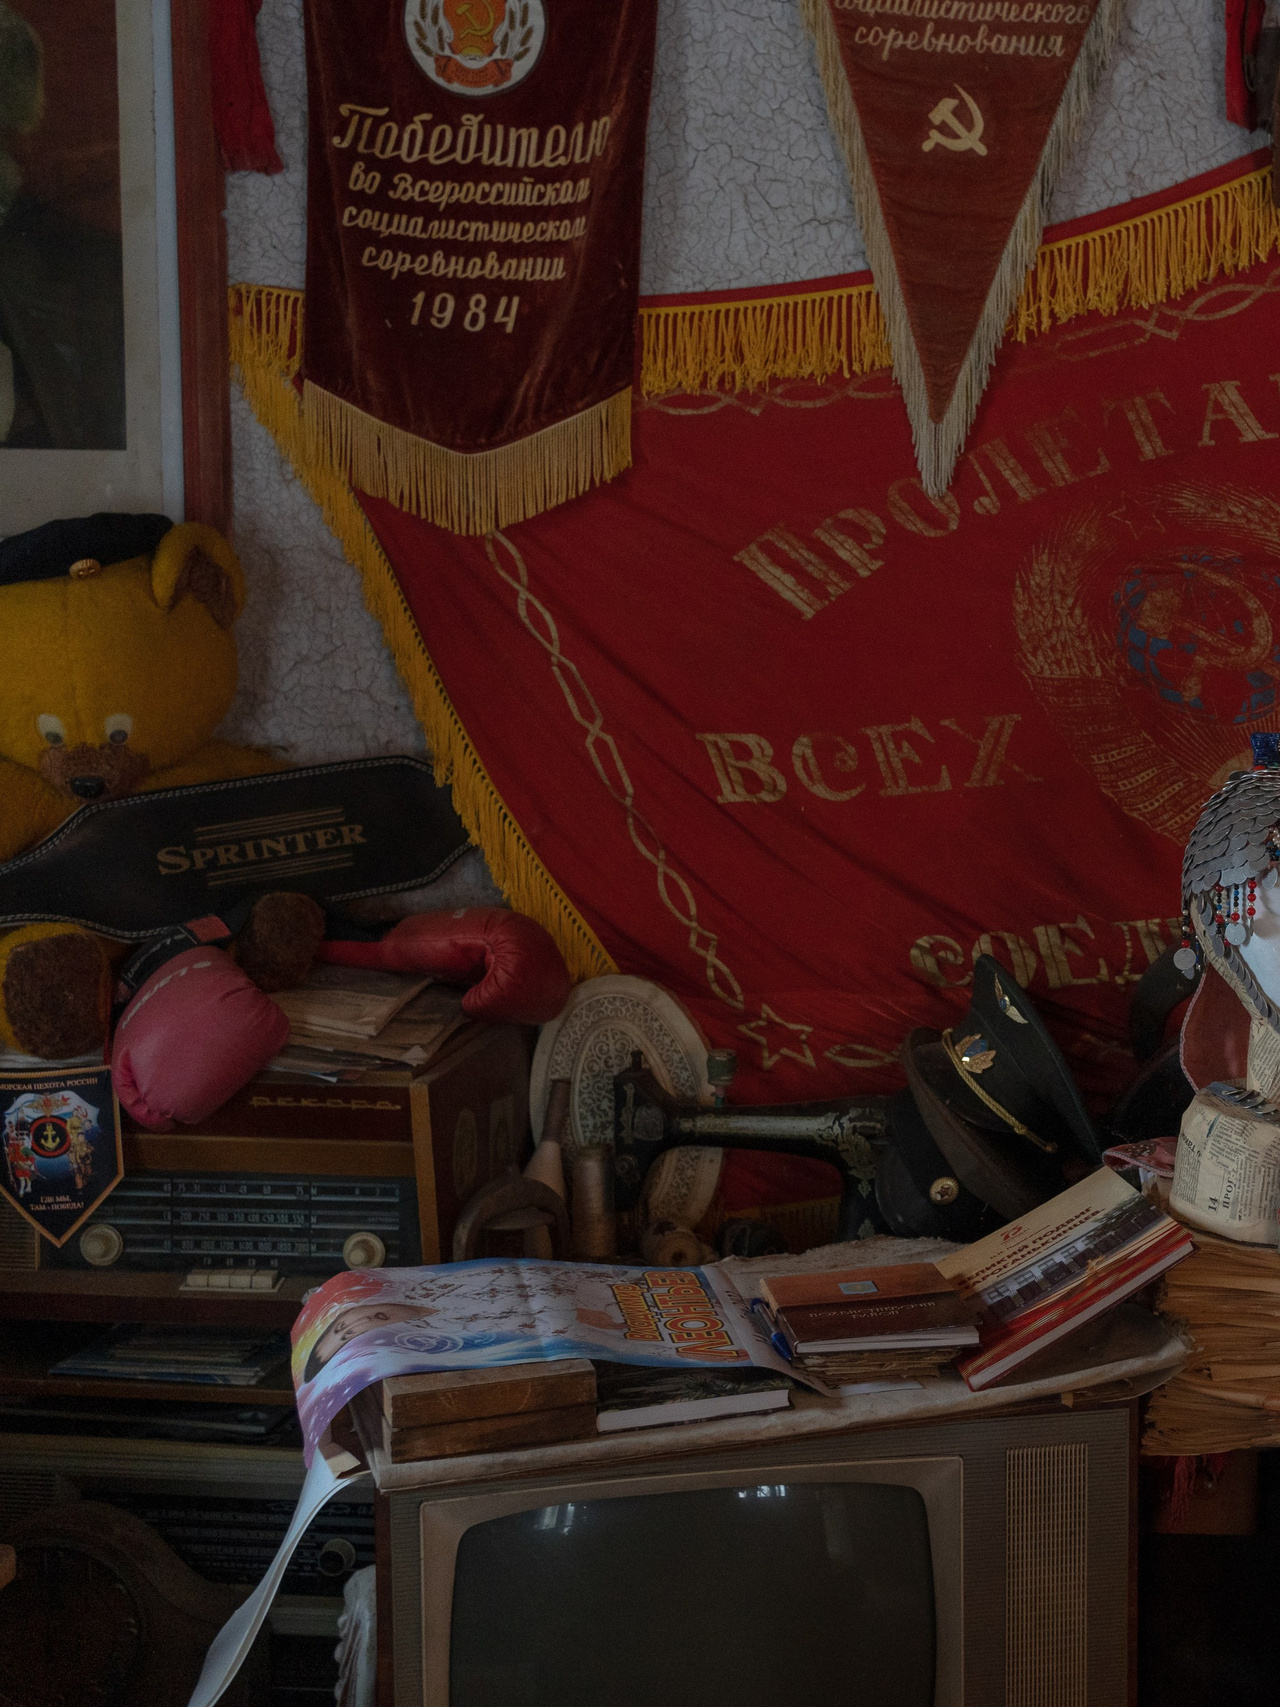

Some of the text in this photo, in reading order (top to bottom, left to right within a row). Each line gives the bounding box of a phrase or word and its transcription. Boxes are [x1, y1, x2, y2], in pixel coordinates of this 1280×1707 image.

[854, 21, 1065, 61] соревнования
[331, 103, 611, 168] Победителю
[348, 161, 591, 212] во Всероссийском
[341, 205, 587, 243] социалистическом
[361, 246, 567, 280] соревновании
[410, 291, 520, 333] 1984
[703, 712, 1042, 806] ВСЕХ
[156, 824, 367, 876] SPRINTER
[67, 1077, 98, 1086] РОССИИ
[1031, 1206, 1093, 1246] ПОДВИГ
